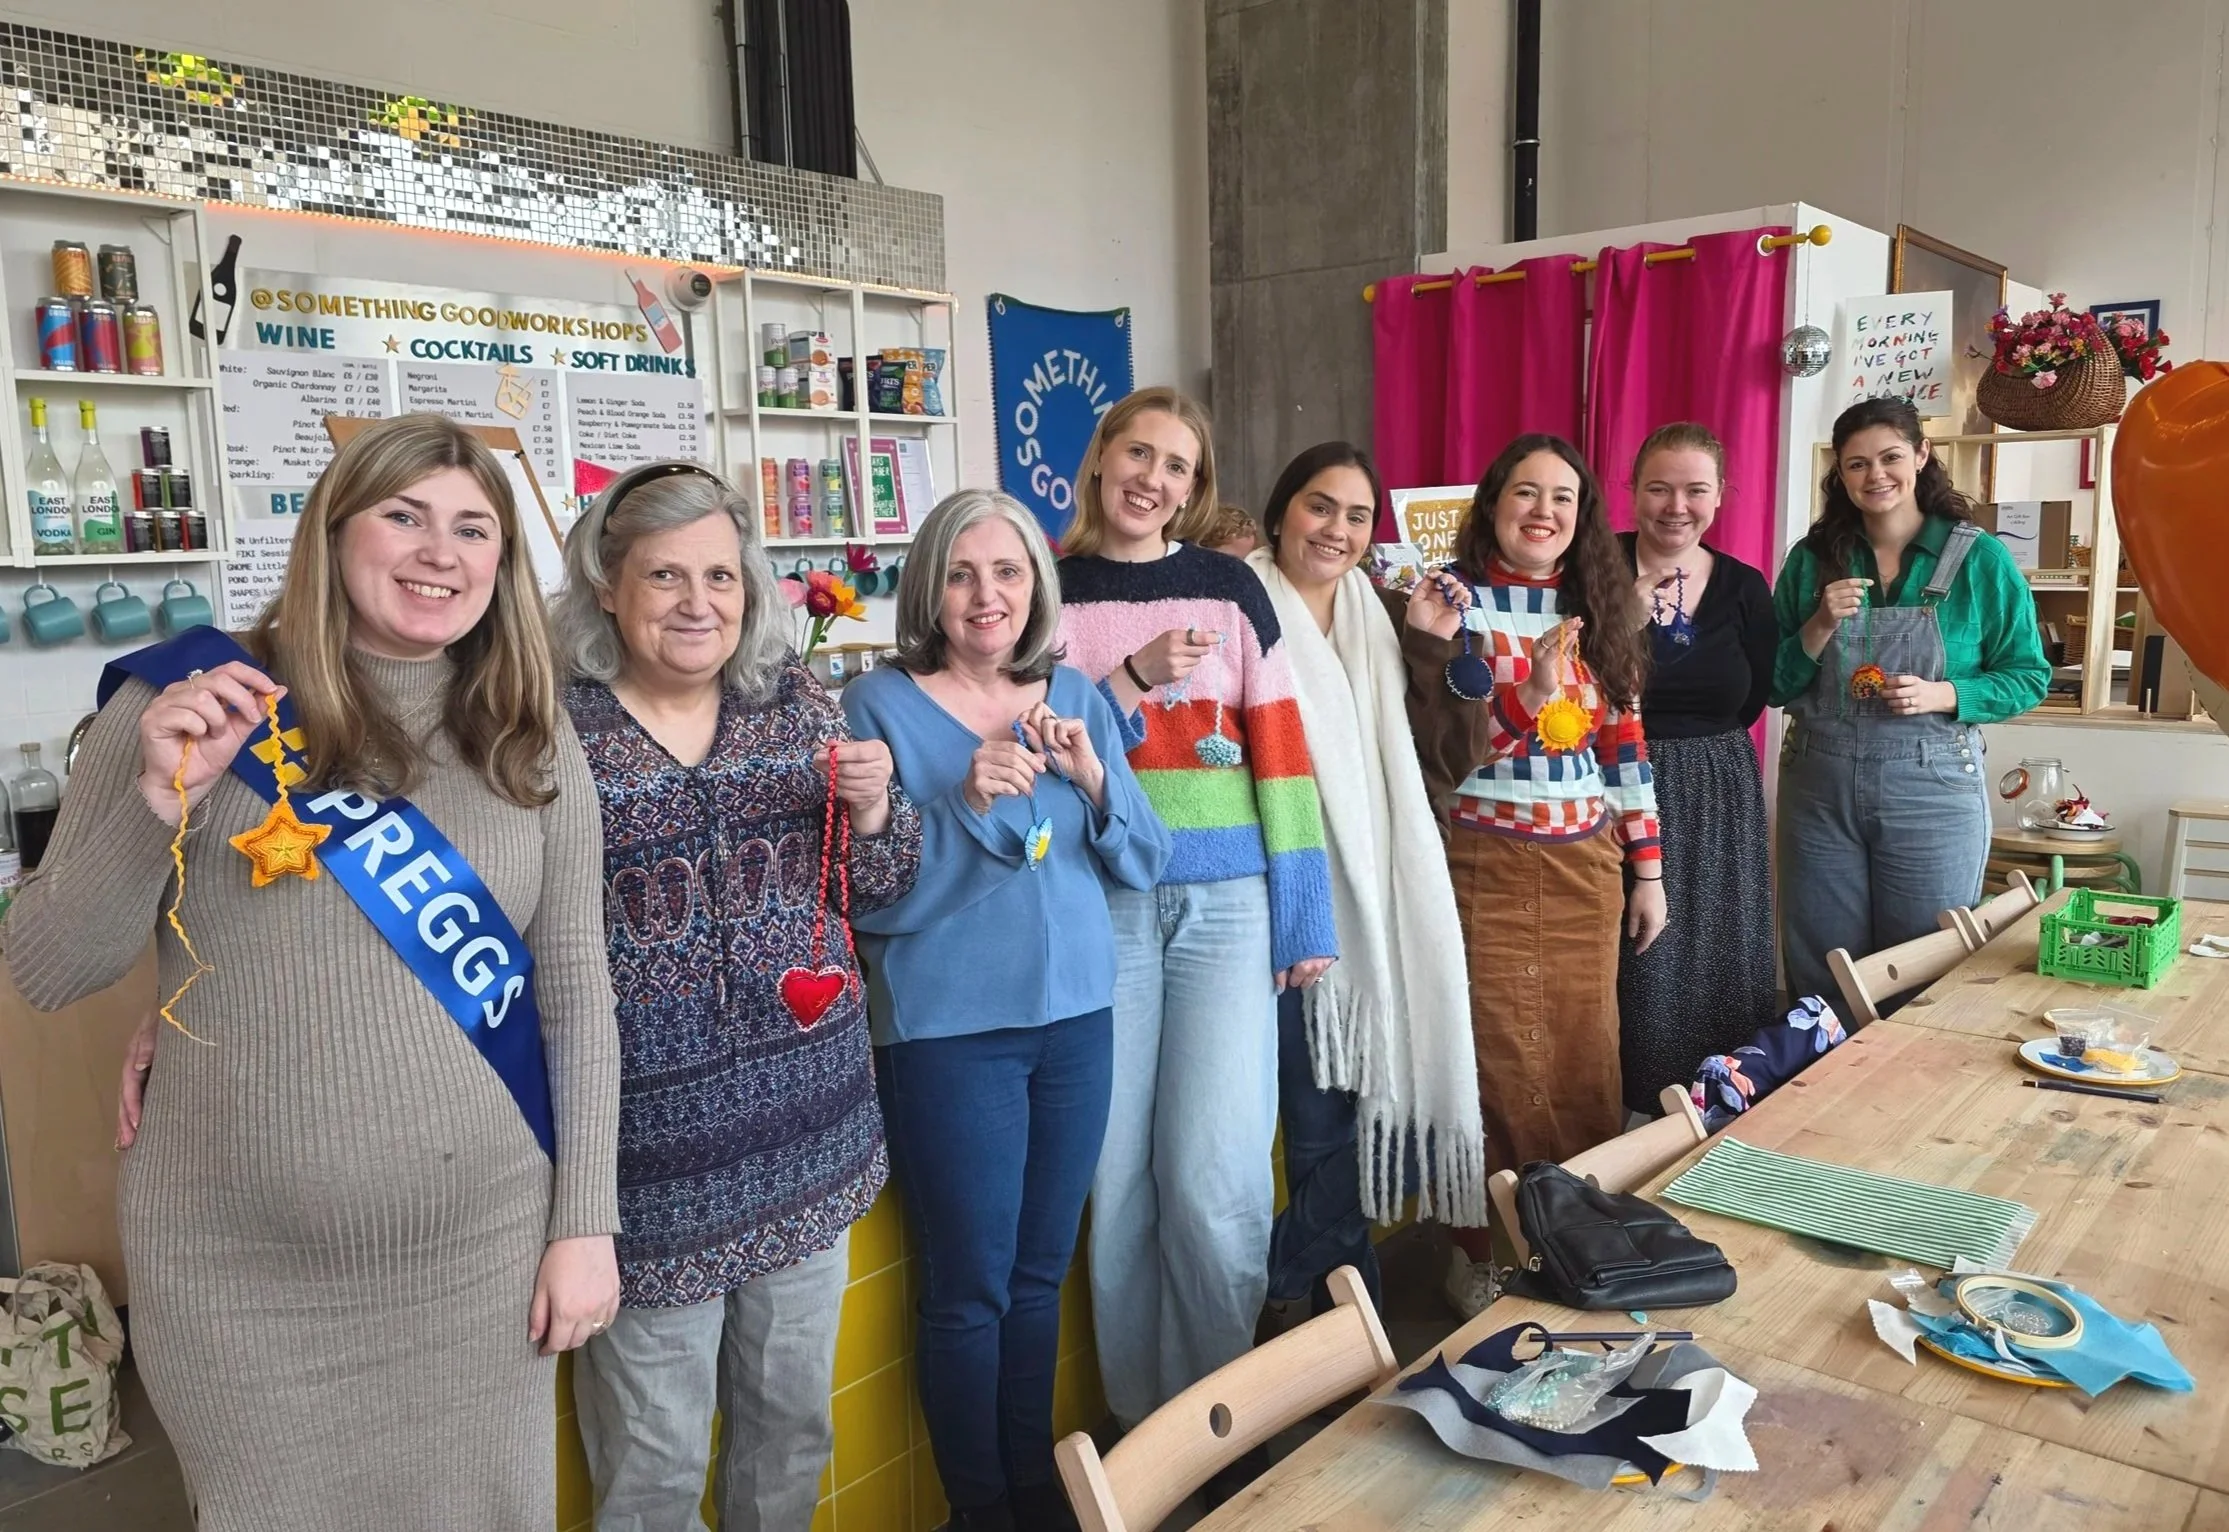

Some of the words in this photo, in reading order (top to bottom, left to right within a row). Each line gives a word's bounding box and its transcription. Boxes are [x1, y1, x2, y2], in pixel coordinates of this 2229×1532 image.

[1857, 311, 1933, 332] EVERY
[256, 322, 335, 349] WINE
[410, 338, 533, 364] COCKTAILS
[1853, 354, 1887, 369] I'VE
[1894, 347, 1933, 369] GOT
[571, 351, 621, 371] SOFT
[625, 354, 696, 379] DRINKS
[267, 367, 309, 378] Sauvignon
[312, 370, 335, 379] Blanc
[407, 371, 438, 381] Negroni
[1853, 375, 1865, 387] A
[1876, 367, 1934, 387] NEW
[253, 379, 288, 389] Organic
[291, 382, 337, 392] Chardonnay
[344, 384, 354, 392] £7
[408, 384, 448, 394] Margarita
[301, 395, 337, 404] Albarino
[409, 396, 444, 406] Espresso
[447, 398, 477, 407] Martini
[606, 399, 629, 407] Ginger
[311, 408, 338, 417] Malbec
[465, 411, 494, 420] Martini
[577, 408, 597, 416] Peach
[606, 409, 625, 417] Blood
[628, 411, 650, 419] Orange
[652, 411, 666, 419] Soda
[293, 420, 316, 429] Pinot
[578, 419, 612, 428] Raspberry
[621, 421, 660, 430] Pomegranate
[663, 422, 676, 430] Soda
[604, 431, 619, 439] Diet
[273, 445, 296, 454] Pinot
[300, 446, 320, 454] Noir
[579, 442, 606, 450] Mexican
[283, 458, 310, 467] Muskat
[580, 453, 592, 461] Big
[609, 454, 627, 462] Spicy
[1031, 464, 1073, 510] GO
[39, 496, 66, 505] EAST
[90, 496, 115, 504] EAST
[271, 493, 305, 514] BE
[82, 505, 120, 513] LONDO
[1411, 509, 1459, 531] JUST
[37, 529, 72, 537] VODKA
[97, 528, 116, 536] GIN
[1418, 530, 1458, 549] ONE
[226, 563, 253, 572] GNOME
[256, 562, 288, 571] Little
[228, 576, 249, 585] POND
[252, 575, 274, 584] Dark
[229, 588, 261, 598] SHAPES
[230, 601, 256, 611] Lucky
[306, 789, 525, 1029] PREGGS
